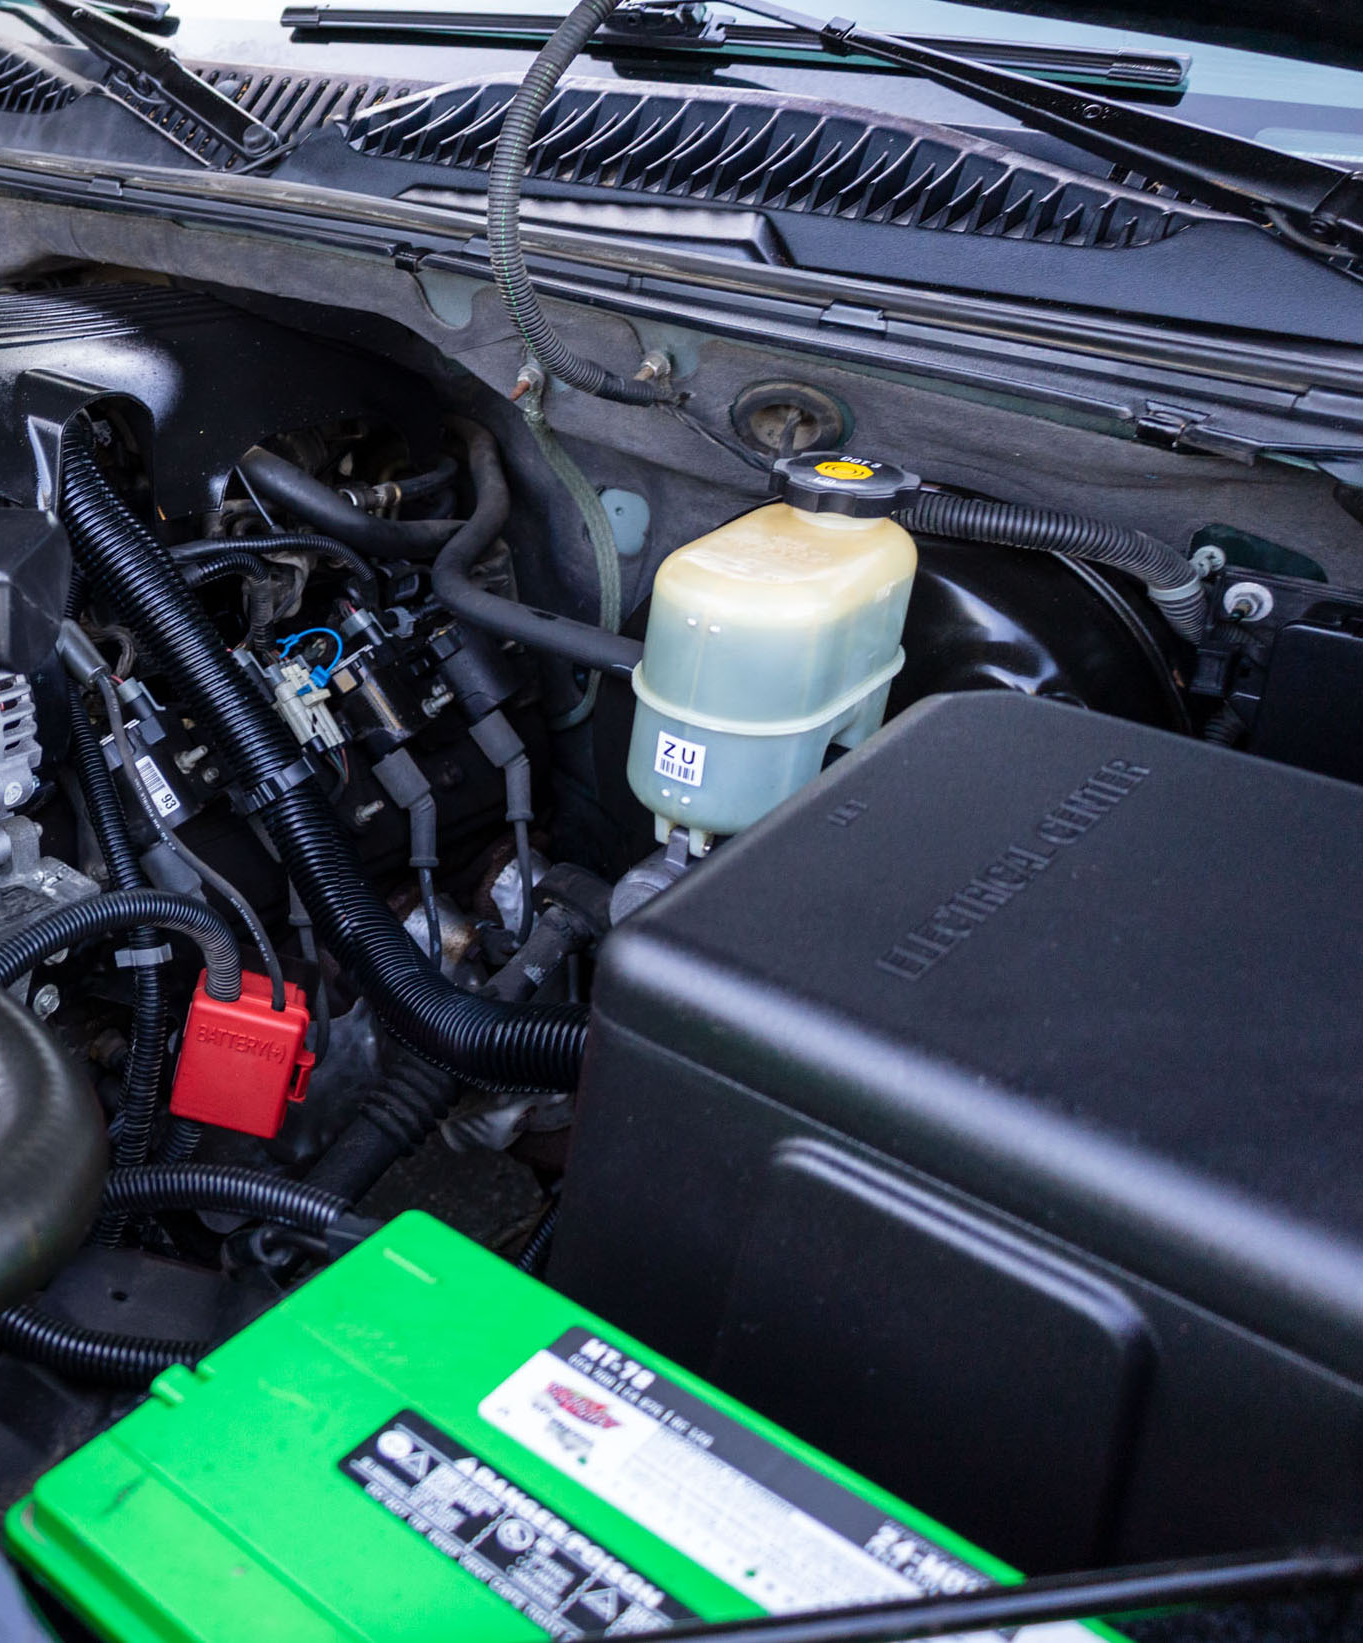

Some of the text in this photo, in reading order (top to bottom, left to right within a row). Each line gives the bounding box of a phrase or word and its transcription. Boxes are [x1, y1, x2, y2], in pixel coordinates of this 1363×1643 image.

[839, 455, 883, 469] DOT 3
[161, 793, 177, 810] 93
[876, 757, 1151, 982] ELECTRICAL CENTER
